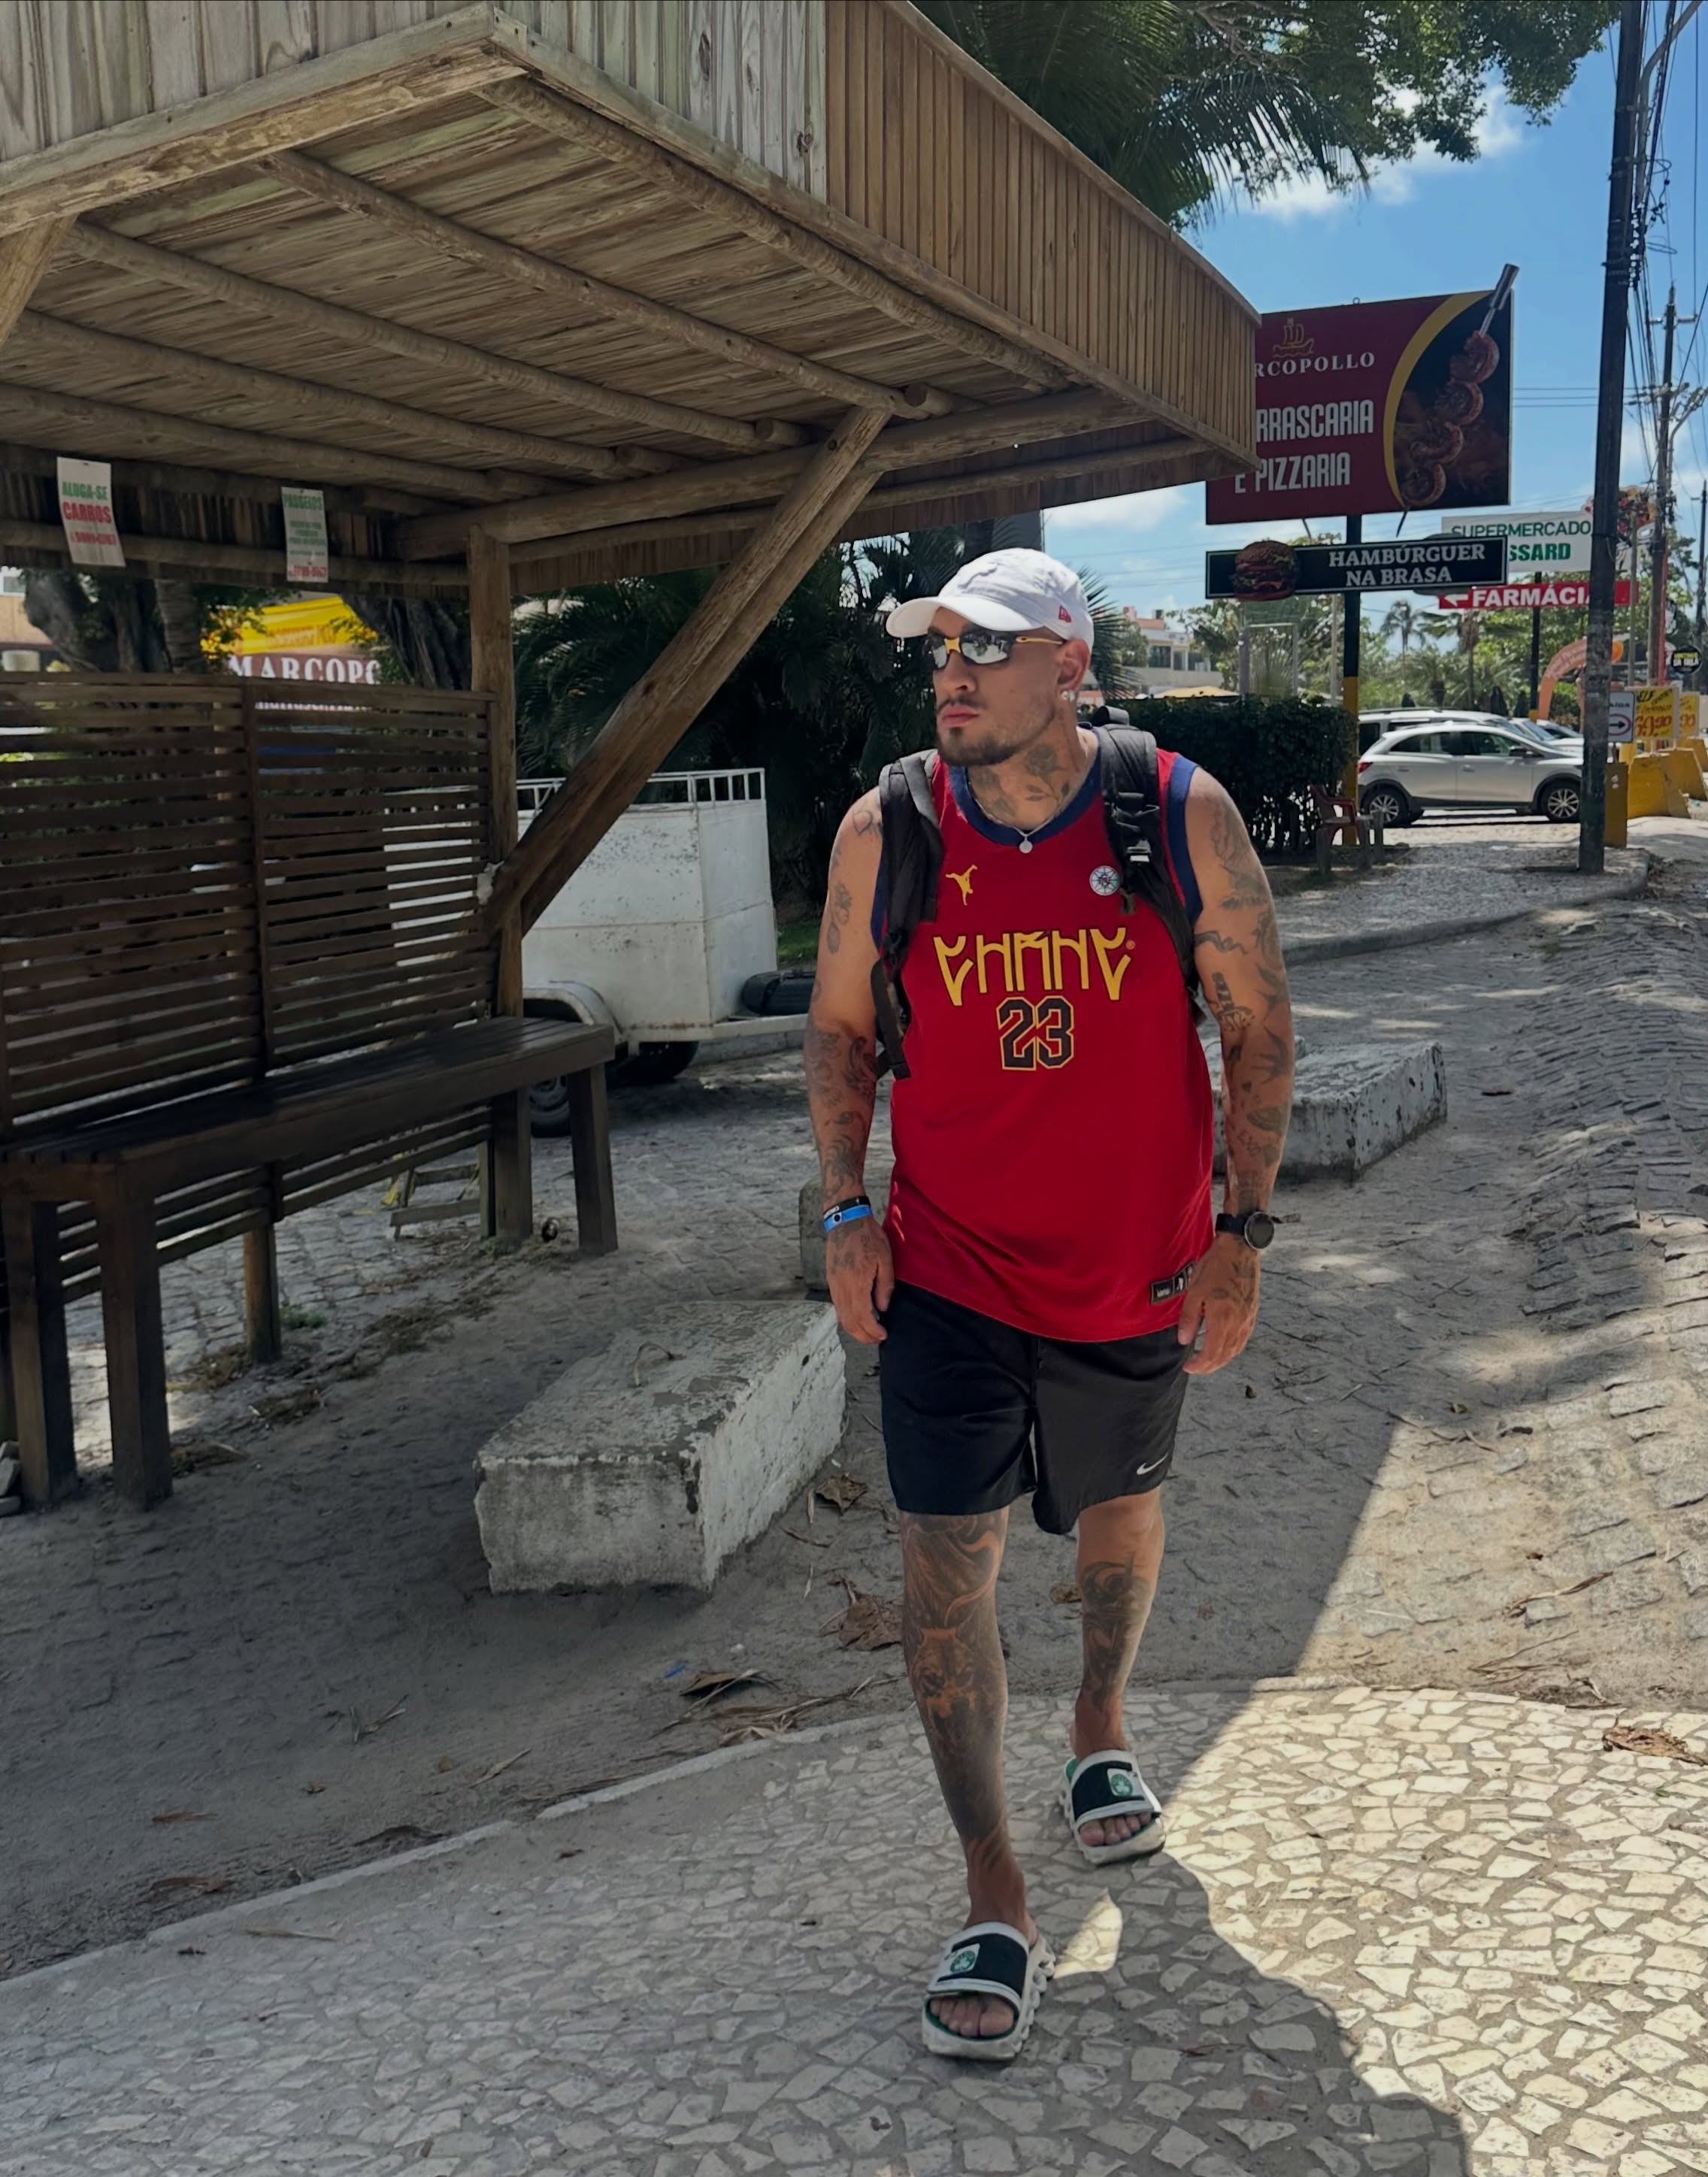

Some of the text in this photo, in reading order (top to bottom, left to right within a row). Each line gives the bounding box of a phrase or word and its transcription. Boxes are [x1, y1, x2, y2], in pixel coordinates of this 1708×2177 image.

[1255, 352, 1375, 377] RCOPOLLO
[1256, 400, 1374, 442] RRASCARIA
[1255, 453, 1350, 492] PIZZARIA
[62, 481, 109, 501] ALUGA-SE
[62, 501, 112, 524] CARROS
[1452, 520, 1591, 537] SUPERMERCADO
[1329, 543, 1485, 567] HAMBÚRGUER
[1509, 543, 1571, 562] SSARD
[1346, 566, 1452, 586] NA BRASA
[1473, 583, 1589, 607] FARMÁCI
[229, 655, 381, 685] MARCOPO
[995, 995, 1075, 1071] 23
